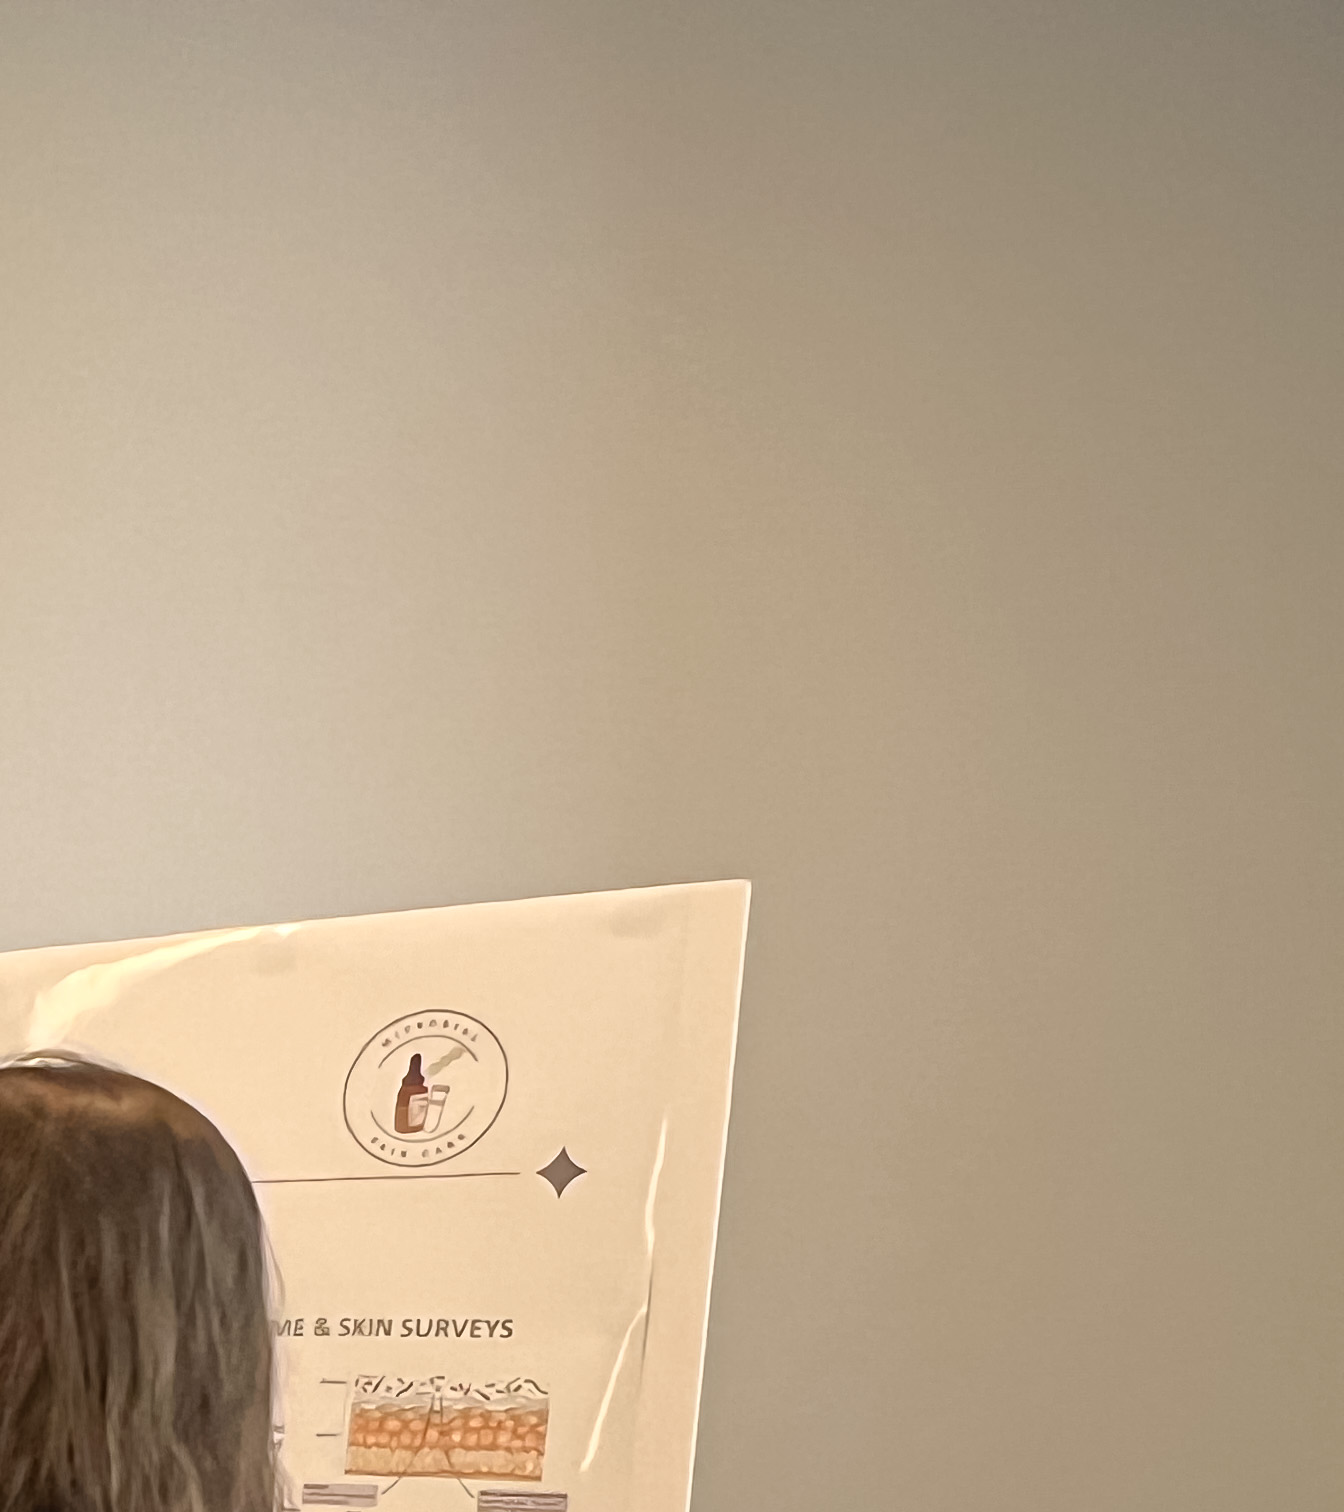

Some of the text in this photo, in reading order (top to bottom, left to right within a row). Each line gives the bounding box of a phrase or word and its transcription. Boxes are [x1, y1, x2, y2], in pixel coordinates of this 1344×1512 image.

[313, 1317, 331, 1337] &
[337, 1317, 394, 1338] SKIN
[399, 1317, 514, 1339] SURVEYS
